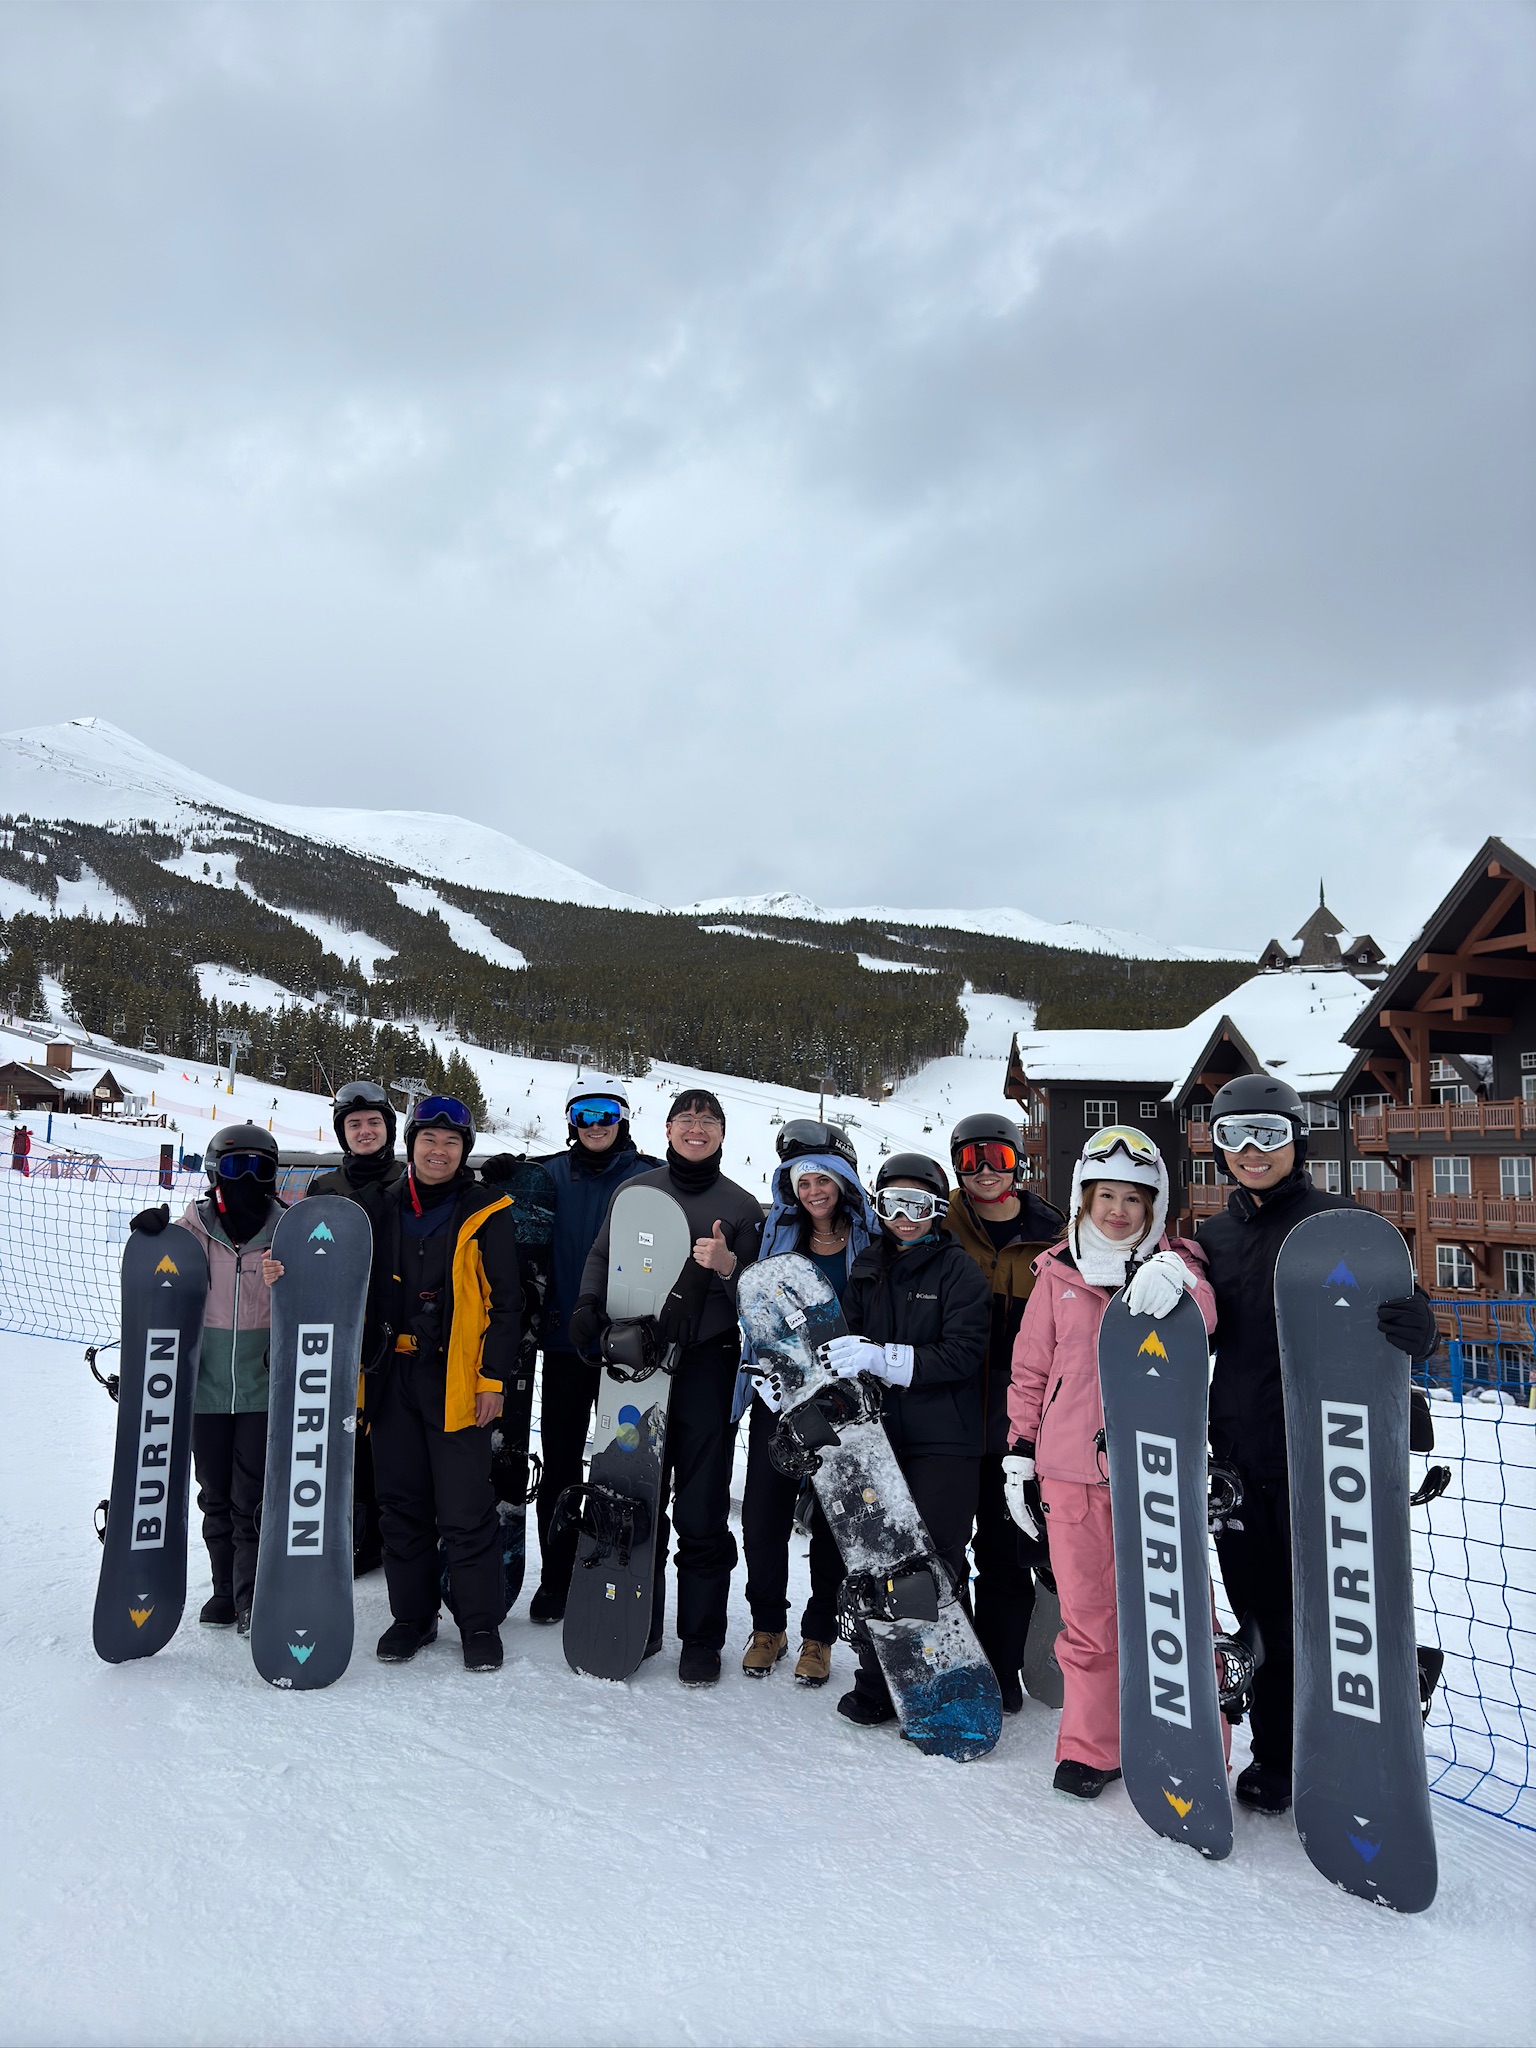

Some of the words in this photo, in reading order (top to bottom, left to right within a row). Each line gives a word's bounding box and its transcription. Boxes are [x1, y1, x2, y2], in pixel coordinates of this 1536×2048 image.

[136, 1337, 176, 1542] BURTON
[292, 1332, 329, 1547] BURTON
[1327, 1412, 1375, 1710] BURTON
[1141, 1442, 1186, 1717] BURTON
